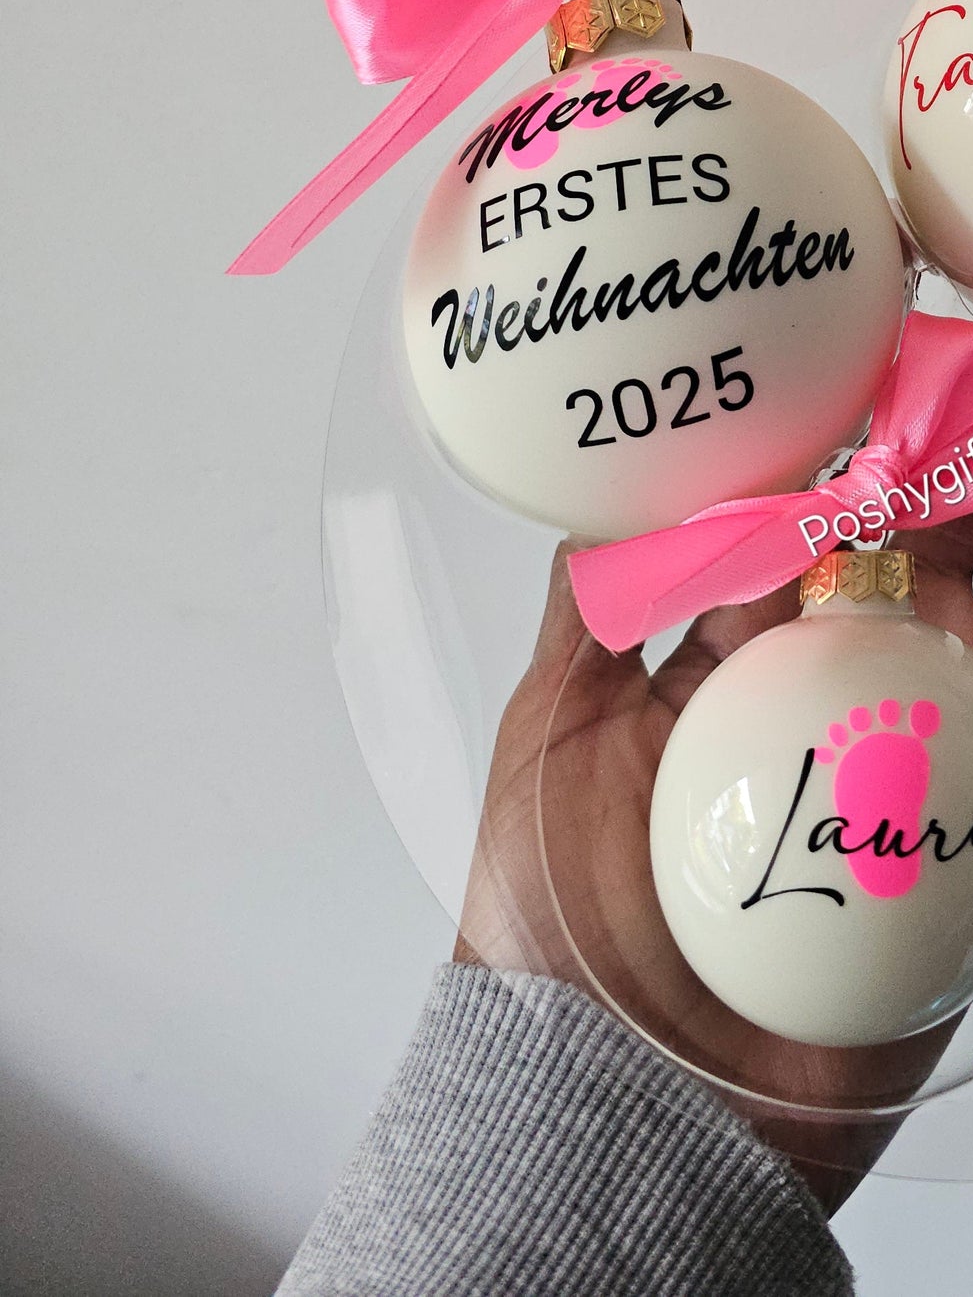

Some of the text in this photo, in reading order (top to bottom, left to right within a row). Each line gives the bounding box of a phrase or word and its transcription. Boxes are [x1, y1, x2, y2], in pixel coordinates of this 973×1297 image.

[458, 69, 733, 184] Merlys
[478, 152, 732, 253] ERSTES
[430, 206, 856, 370] Weihnachten
[564, 345, 755, 449] 2025
